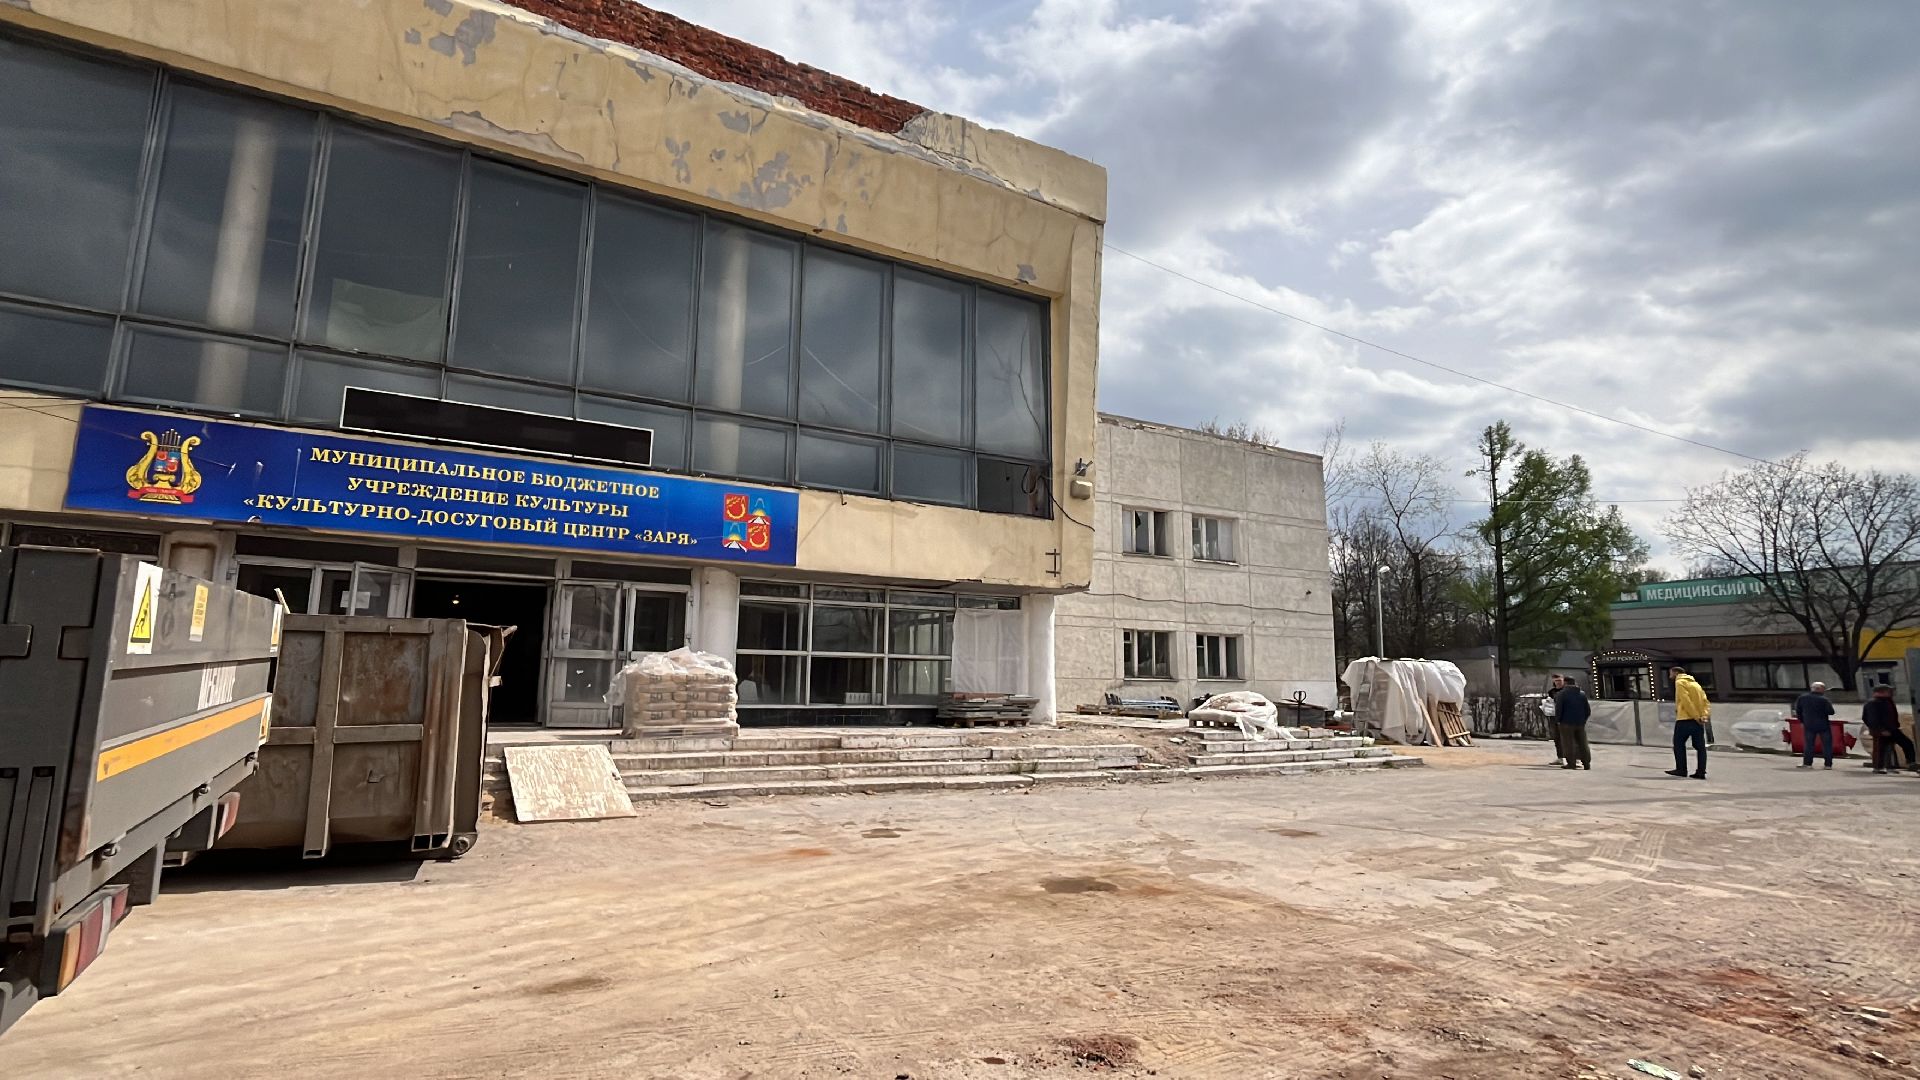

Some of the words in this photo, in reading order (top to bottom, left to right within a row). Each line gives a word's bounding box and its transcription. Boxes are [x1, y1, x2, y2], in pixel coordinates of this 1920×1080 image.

[310, 447, 525, 484] МУНИЦИПАЛЬНОЕ
[531, 473, 660, 499] БЮДЖЕТНОЕ
[243, 494, 558, 534] «КУЛЬТУРНО-ДОСУГОВЫЙ
[563, 522, 630, 540] ЦЕНТР
[634, 529, 698, 546] «ЗАРЯ»
[347, 477, 509, 506] УЧРЕЖДЕНИЕ
[515, 494, 629, 518] КУЛЬТУРЫ
[1646, 581, 1747, 601] МЕДИЦИНСКИЙ
